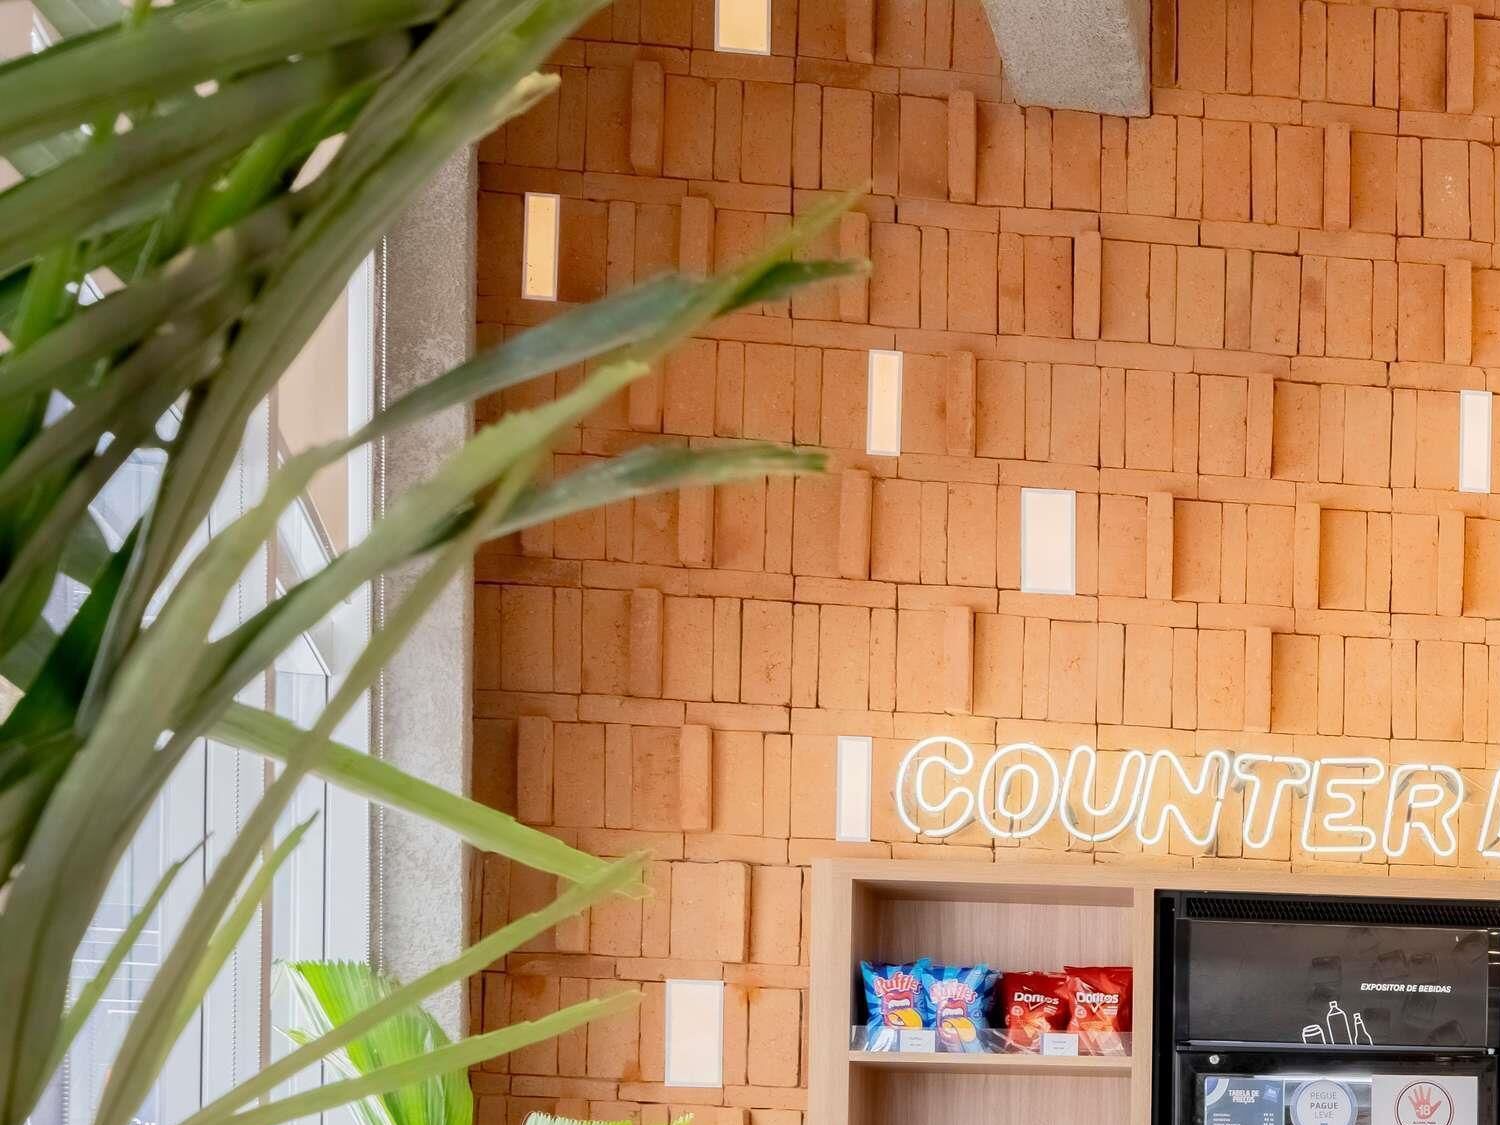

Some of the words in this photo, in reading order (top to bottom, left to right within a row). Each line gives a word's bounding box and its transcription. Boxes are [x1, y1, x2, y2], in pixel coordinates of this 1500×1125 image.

[898, 736, 1464, 858] COUNTER
[1360, 983, 1406, 992] EXPOSITOR
[1406, 984, 1418, 992] DE
[1419, 984, 1452, 993] BEBIDAS
[1014, 992, 1059, 1005] Doritos
[1076, 991, 1119, 1004] Doritos
[1310, 1102, 1339, 1110] PAGUE
